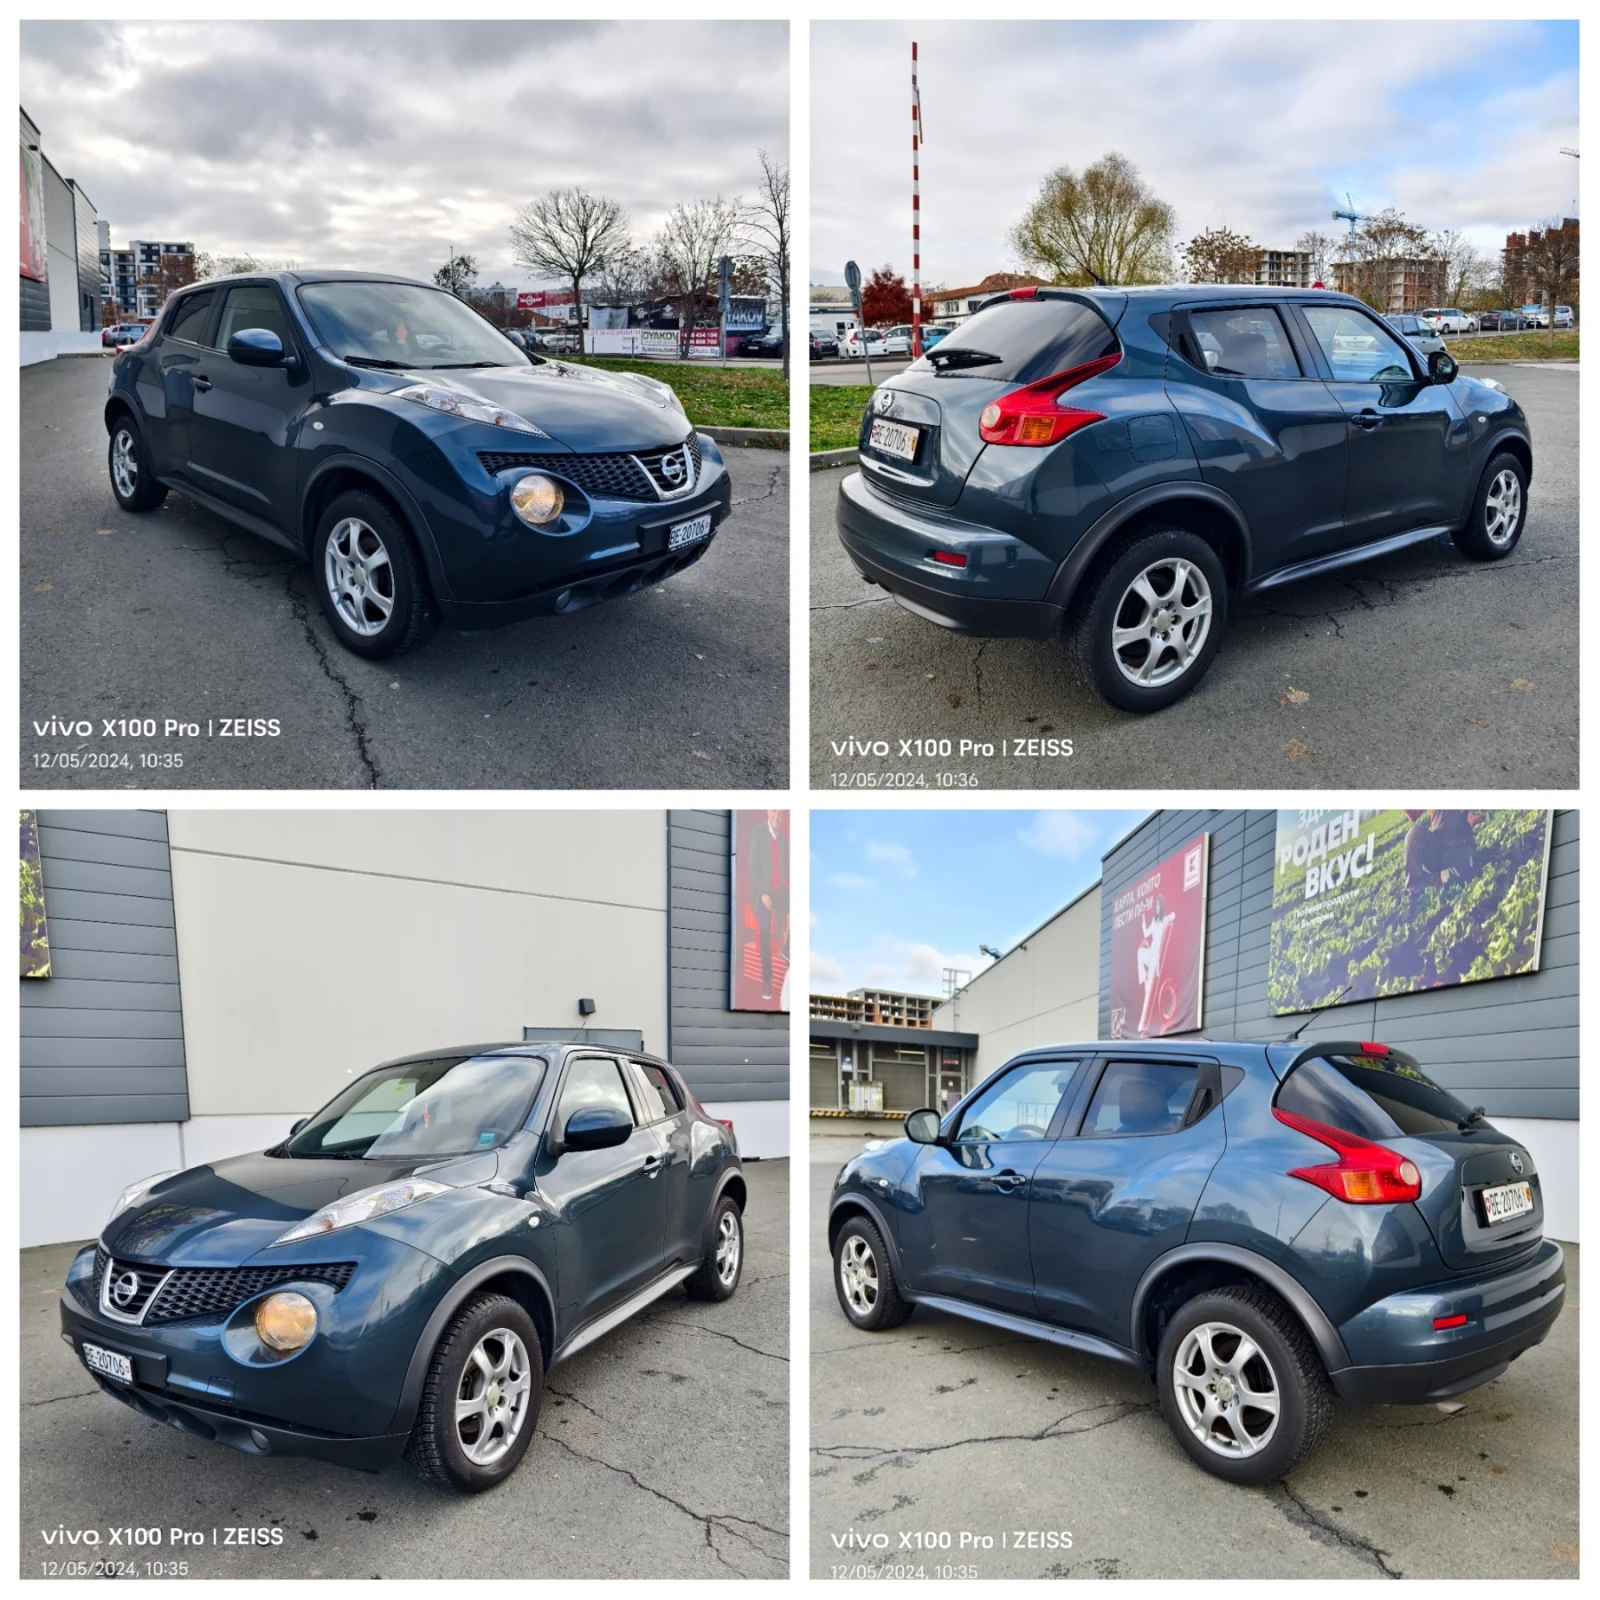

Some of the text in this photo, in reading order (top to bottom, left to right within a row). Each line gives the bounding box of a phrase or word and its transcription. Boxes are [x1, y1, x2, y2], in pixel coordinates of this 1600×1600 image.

[643, 331, 679, 341] DYAKOV
[1280, 809, 1360, 875] РОДЕН
[1305, 832, 1375, 899] ВКУС!
[1137, 872, 1161, 900] КОЯТО
[1113, 907, 1134, 930] ПЕСТИ
